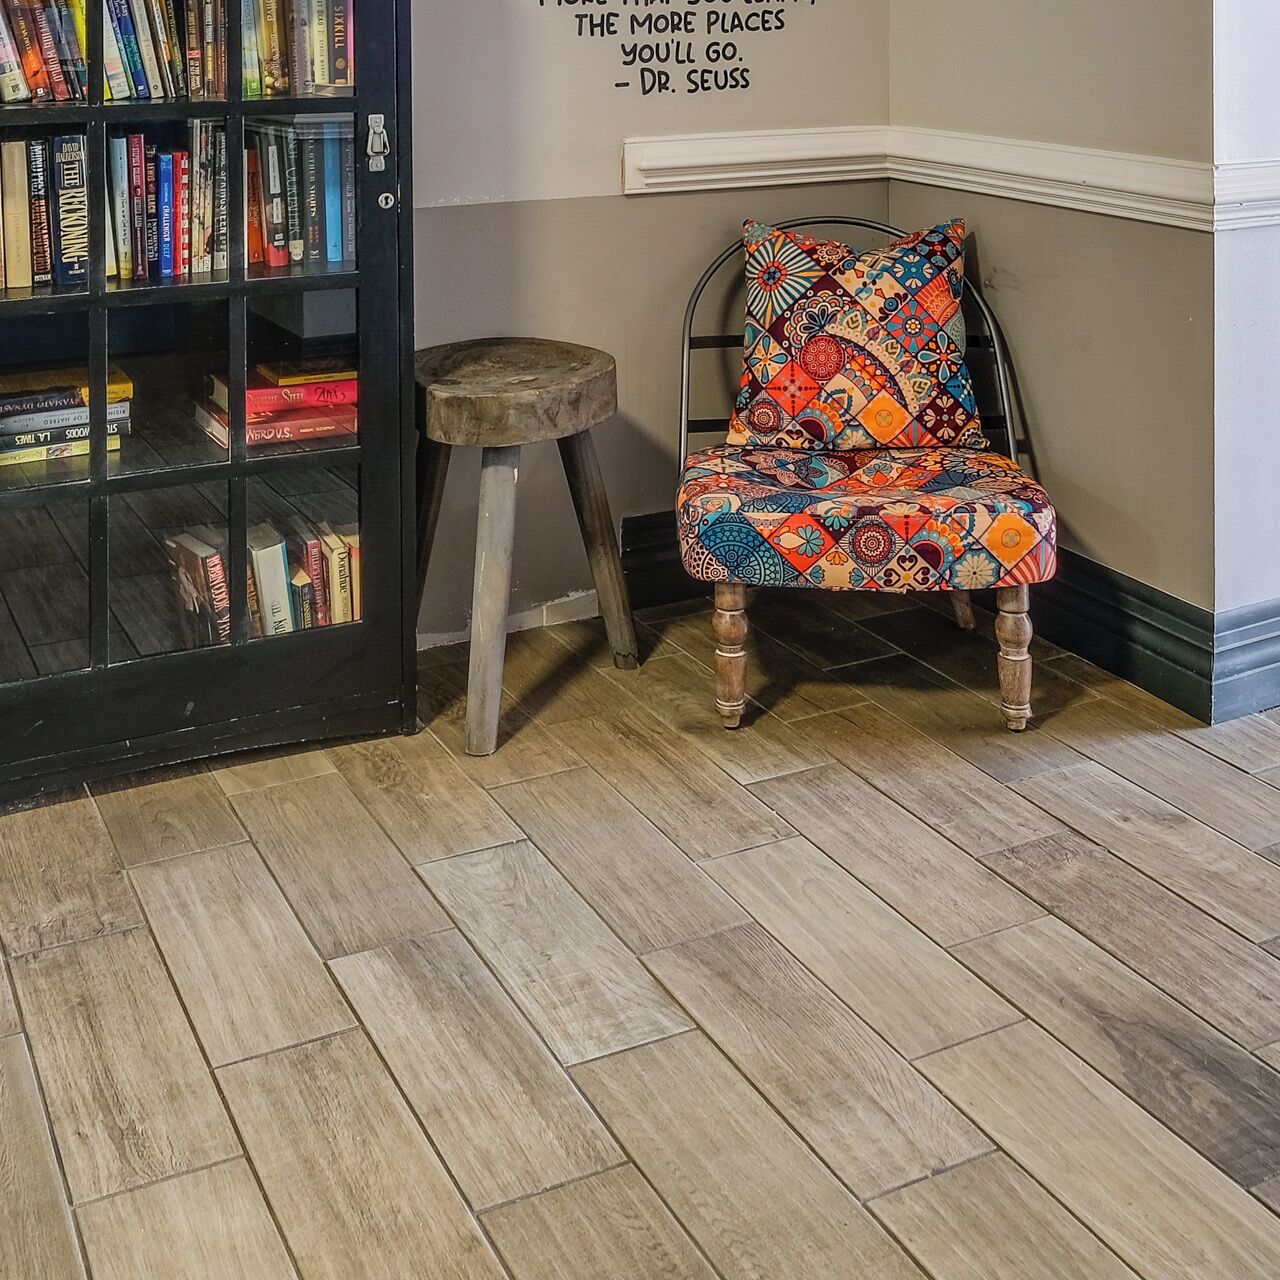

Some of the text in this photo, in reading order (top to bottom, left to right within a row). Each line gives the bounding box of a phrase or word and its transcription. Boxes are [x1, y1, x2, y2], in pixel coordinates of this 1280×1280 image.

[334, 6, 345, 49] SIXKILL
[574, 8, 786, 38] THE MORE PLACES
[47, 49, 64, 82] WORLD
[620, 38, 744, 66] YOU'LL GO.
[639, 67, 676, 96] DR.
[686, 66, 750, 94] SEUSS
[62, 143, 79, 152] DAVID
[64, 162, 80, 187] THE
[146, 163, 156, 214] LEWIS BLACK
[308, 184, 317, 217] NIGHTS
[59, 187, 88, 263] RECKONING
[162, 205, 170, 257] CHALLENGER DEEP
[37, 398, 75, 410] YAMATO
[15, 435, 36, 446] TIMES
[38, 432, 51, 443] L.A.
[275, 427, 293, 439] U.S.
[207, 555, 225, 585] ROBIN
[337, 550, 350, 594] Donahue
[212, 583, 230, 612] COOK
